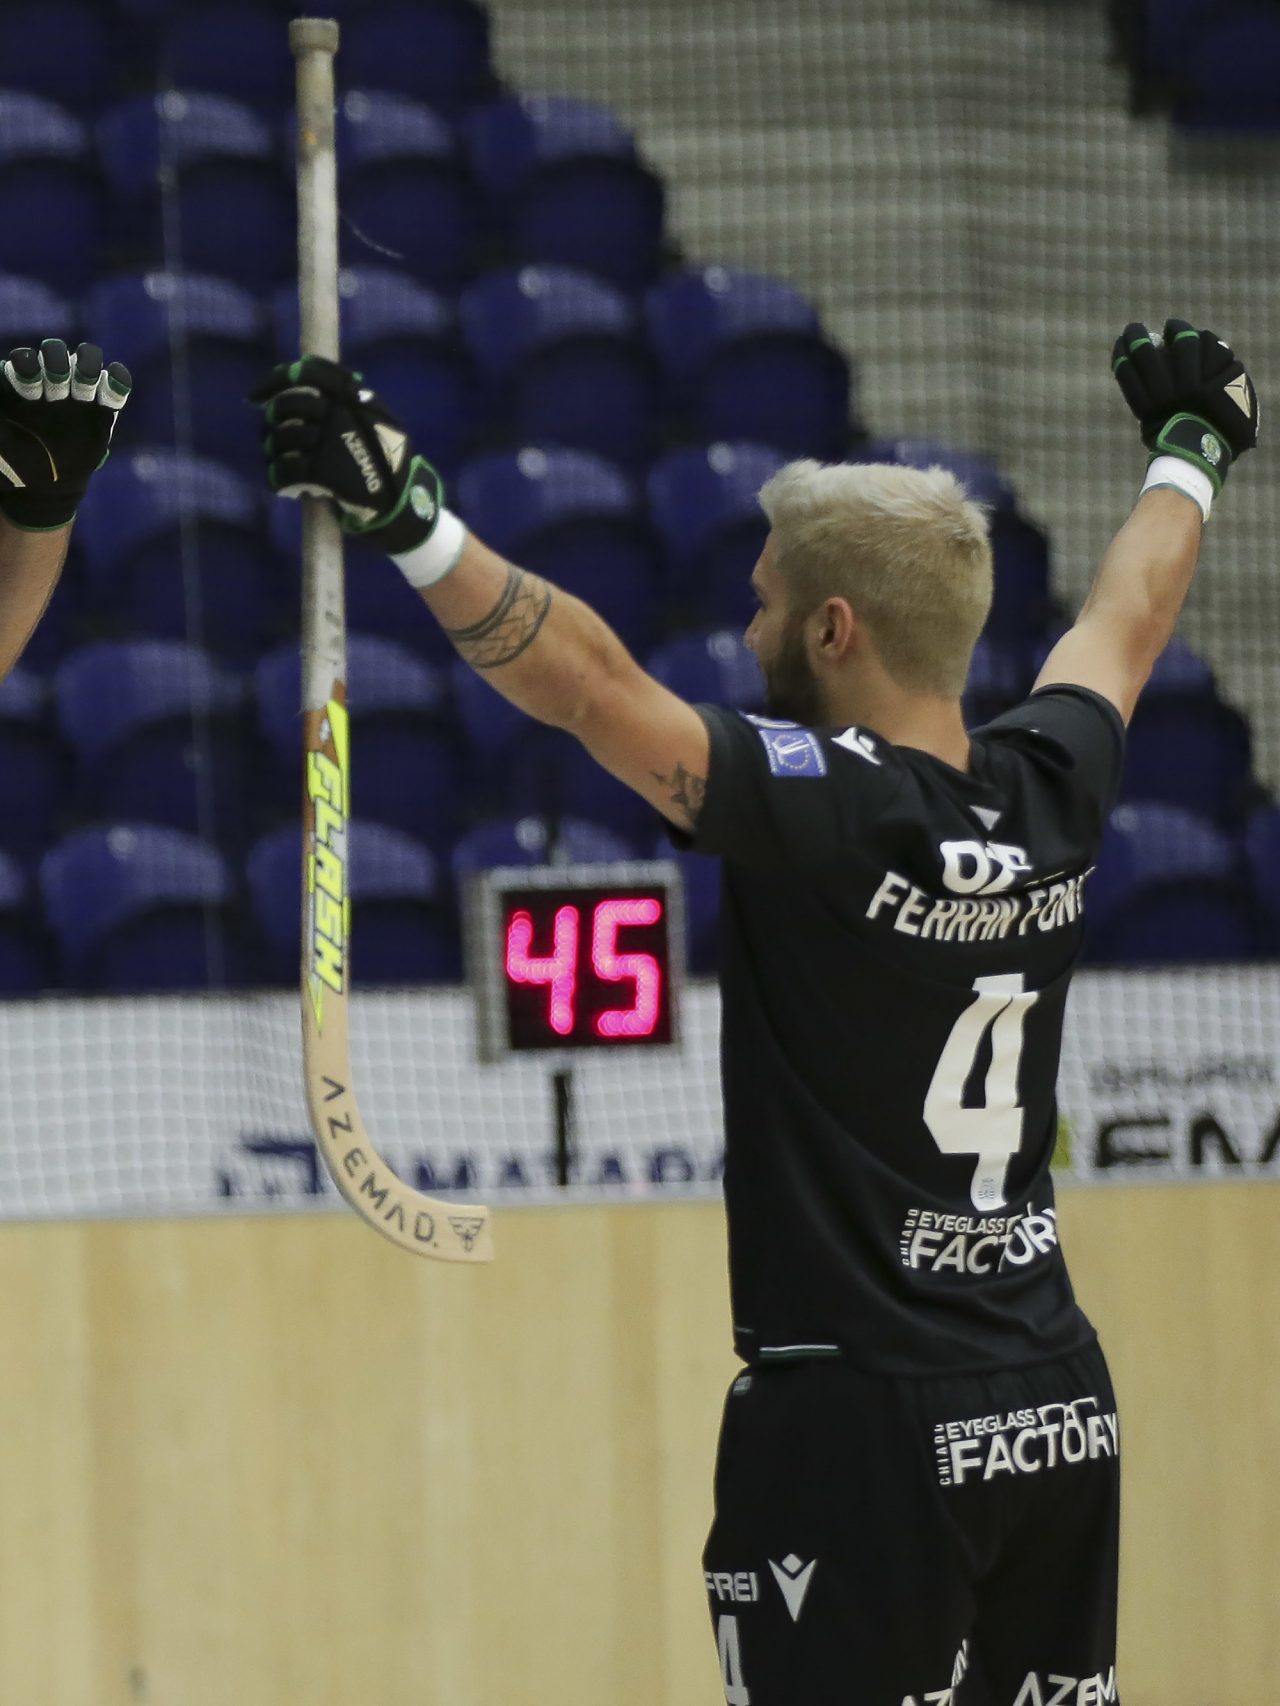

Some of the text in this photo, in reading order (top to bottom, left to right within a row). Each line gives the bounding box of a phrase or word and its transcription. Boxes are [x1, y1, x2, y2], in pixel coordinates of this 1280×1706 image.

[312, 750, 345, 995] FLASH
[865, 870, 1020, 942] FERRAN
[505, 898, 662, 1037] 45
[922, 972, 1040, 1212] 4
[946, 1408, 1037, 1440] EYEGLASS
